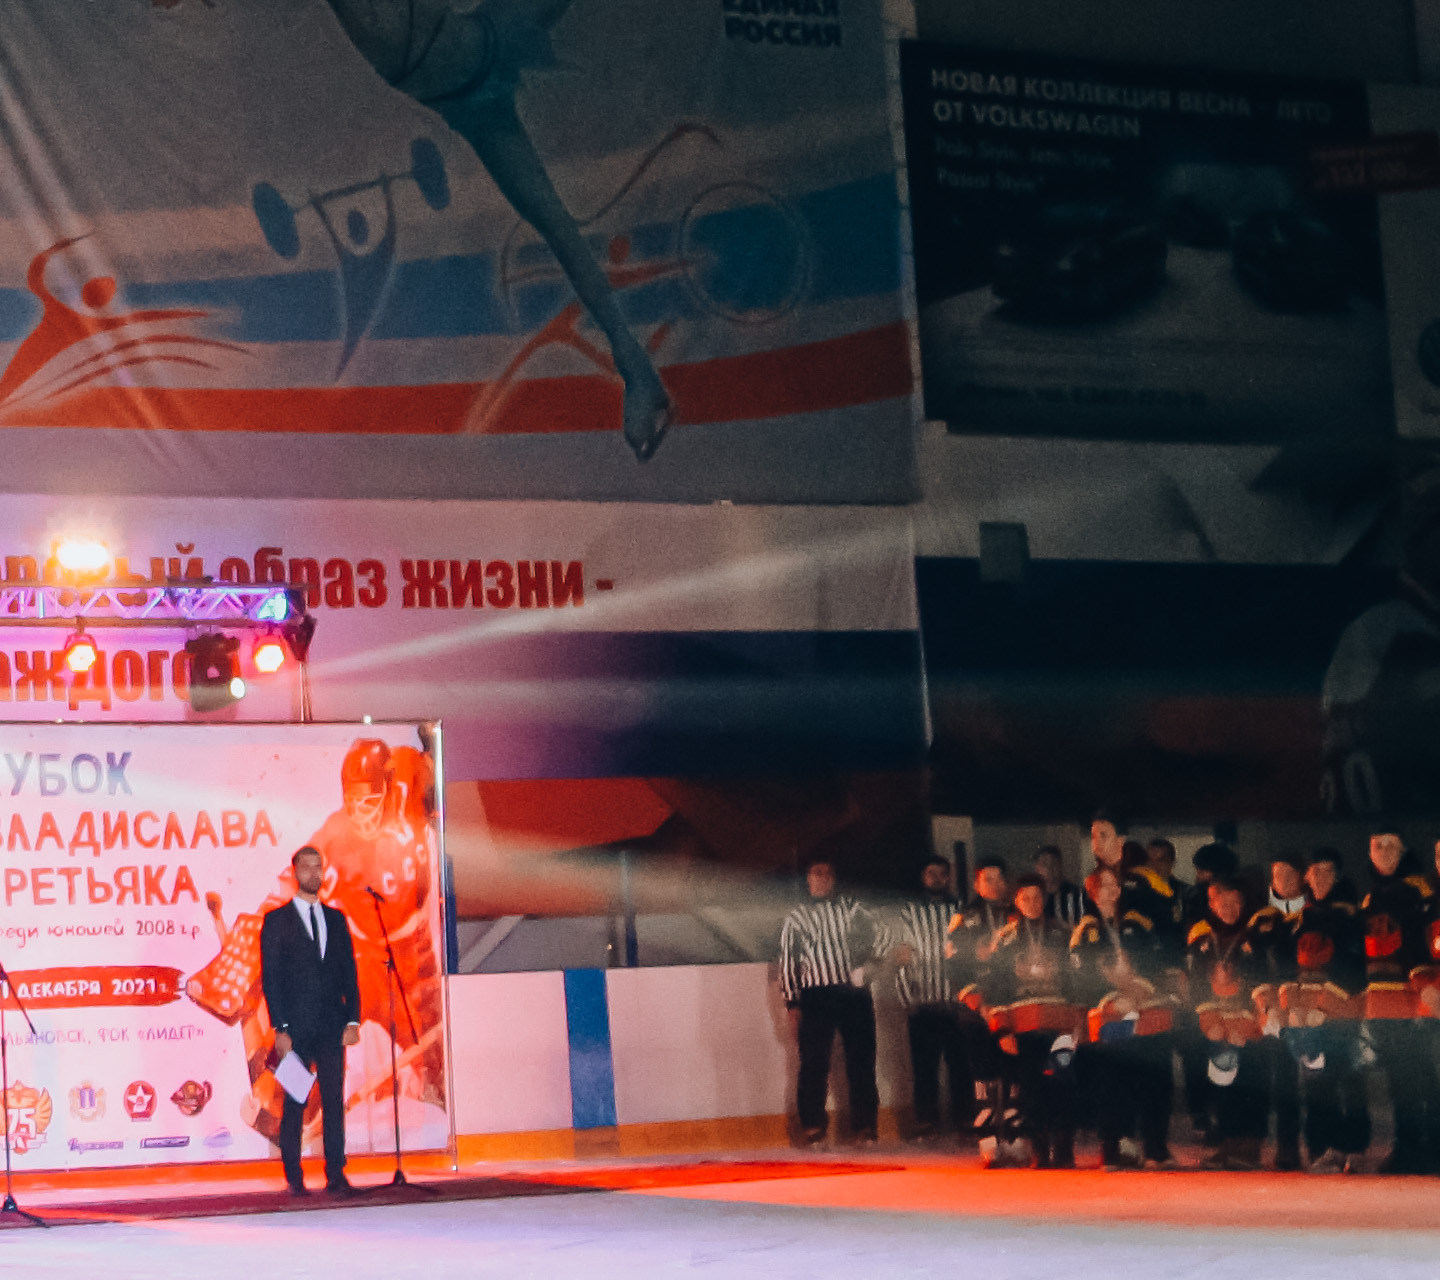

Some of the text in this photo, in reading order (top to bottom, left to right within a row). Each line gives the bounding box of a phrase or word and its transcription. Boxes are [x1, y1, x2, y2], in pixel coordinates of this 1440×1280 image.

[724, 17, 843, 47] РОССИЯ
[931, 68, 1018, 97] НОВАЯ
[1024, 77, 1172, 112] КОЛЛЕКЦИЯ
[1177, 90, 1251, 117] ВЕСНА
[932, 102, 1141, 138] ОТ VOLKSWAGEN
[400, 558, 585, 610] жизни
[46, 918, 125, 937] юношей
[136, 919, 176, 936] 2008
[16, 979, 102, 999] ДЕКАБРЯ
[111, 977, 157, 996] 2021
[3, 1028, 92, 1047] ЛЬЯНОВСК,
